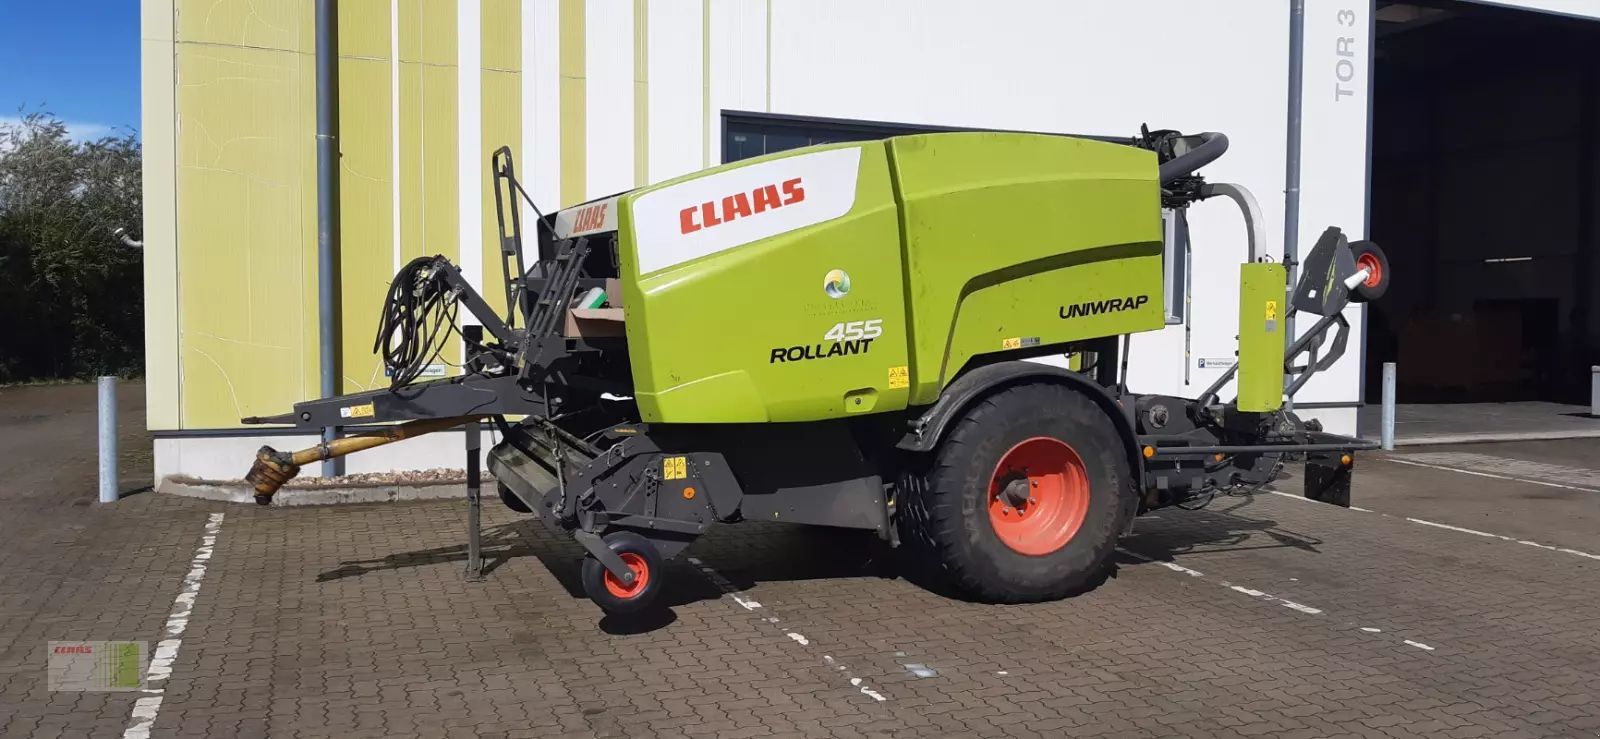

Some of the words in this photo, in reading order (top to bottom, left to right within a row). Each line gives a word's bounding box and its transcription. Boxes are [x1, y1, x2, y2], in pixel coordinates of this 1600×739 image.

[1337, 9, 1355, 27] 3
[1335, 37, 1354, 102] TOR
[573, 203, 608, 233] CLAAS
[680, 178, 805, 235] CLAAS
[1059, 296, 1148, 319] UNIWRAP
[824, 319, 882, 341] 455
[770, 338, 873, 363] ROLLANT
